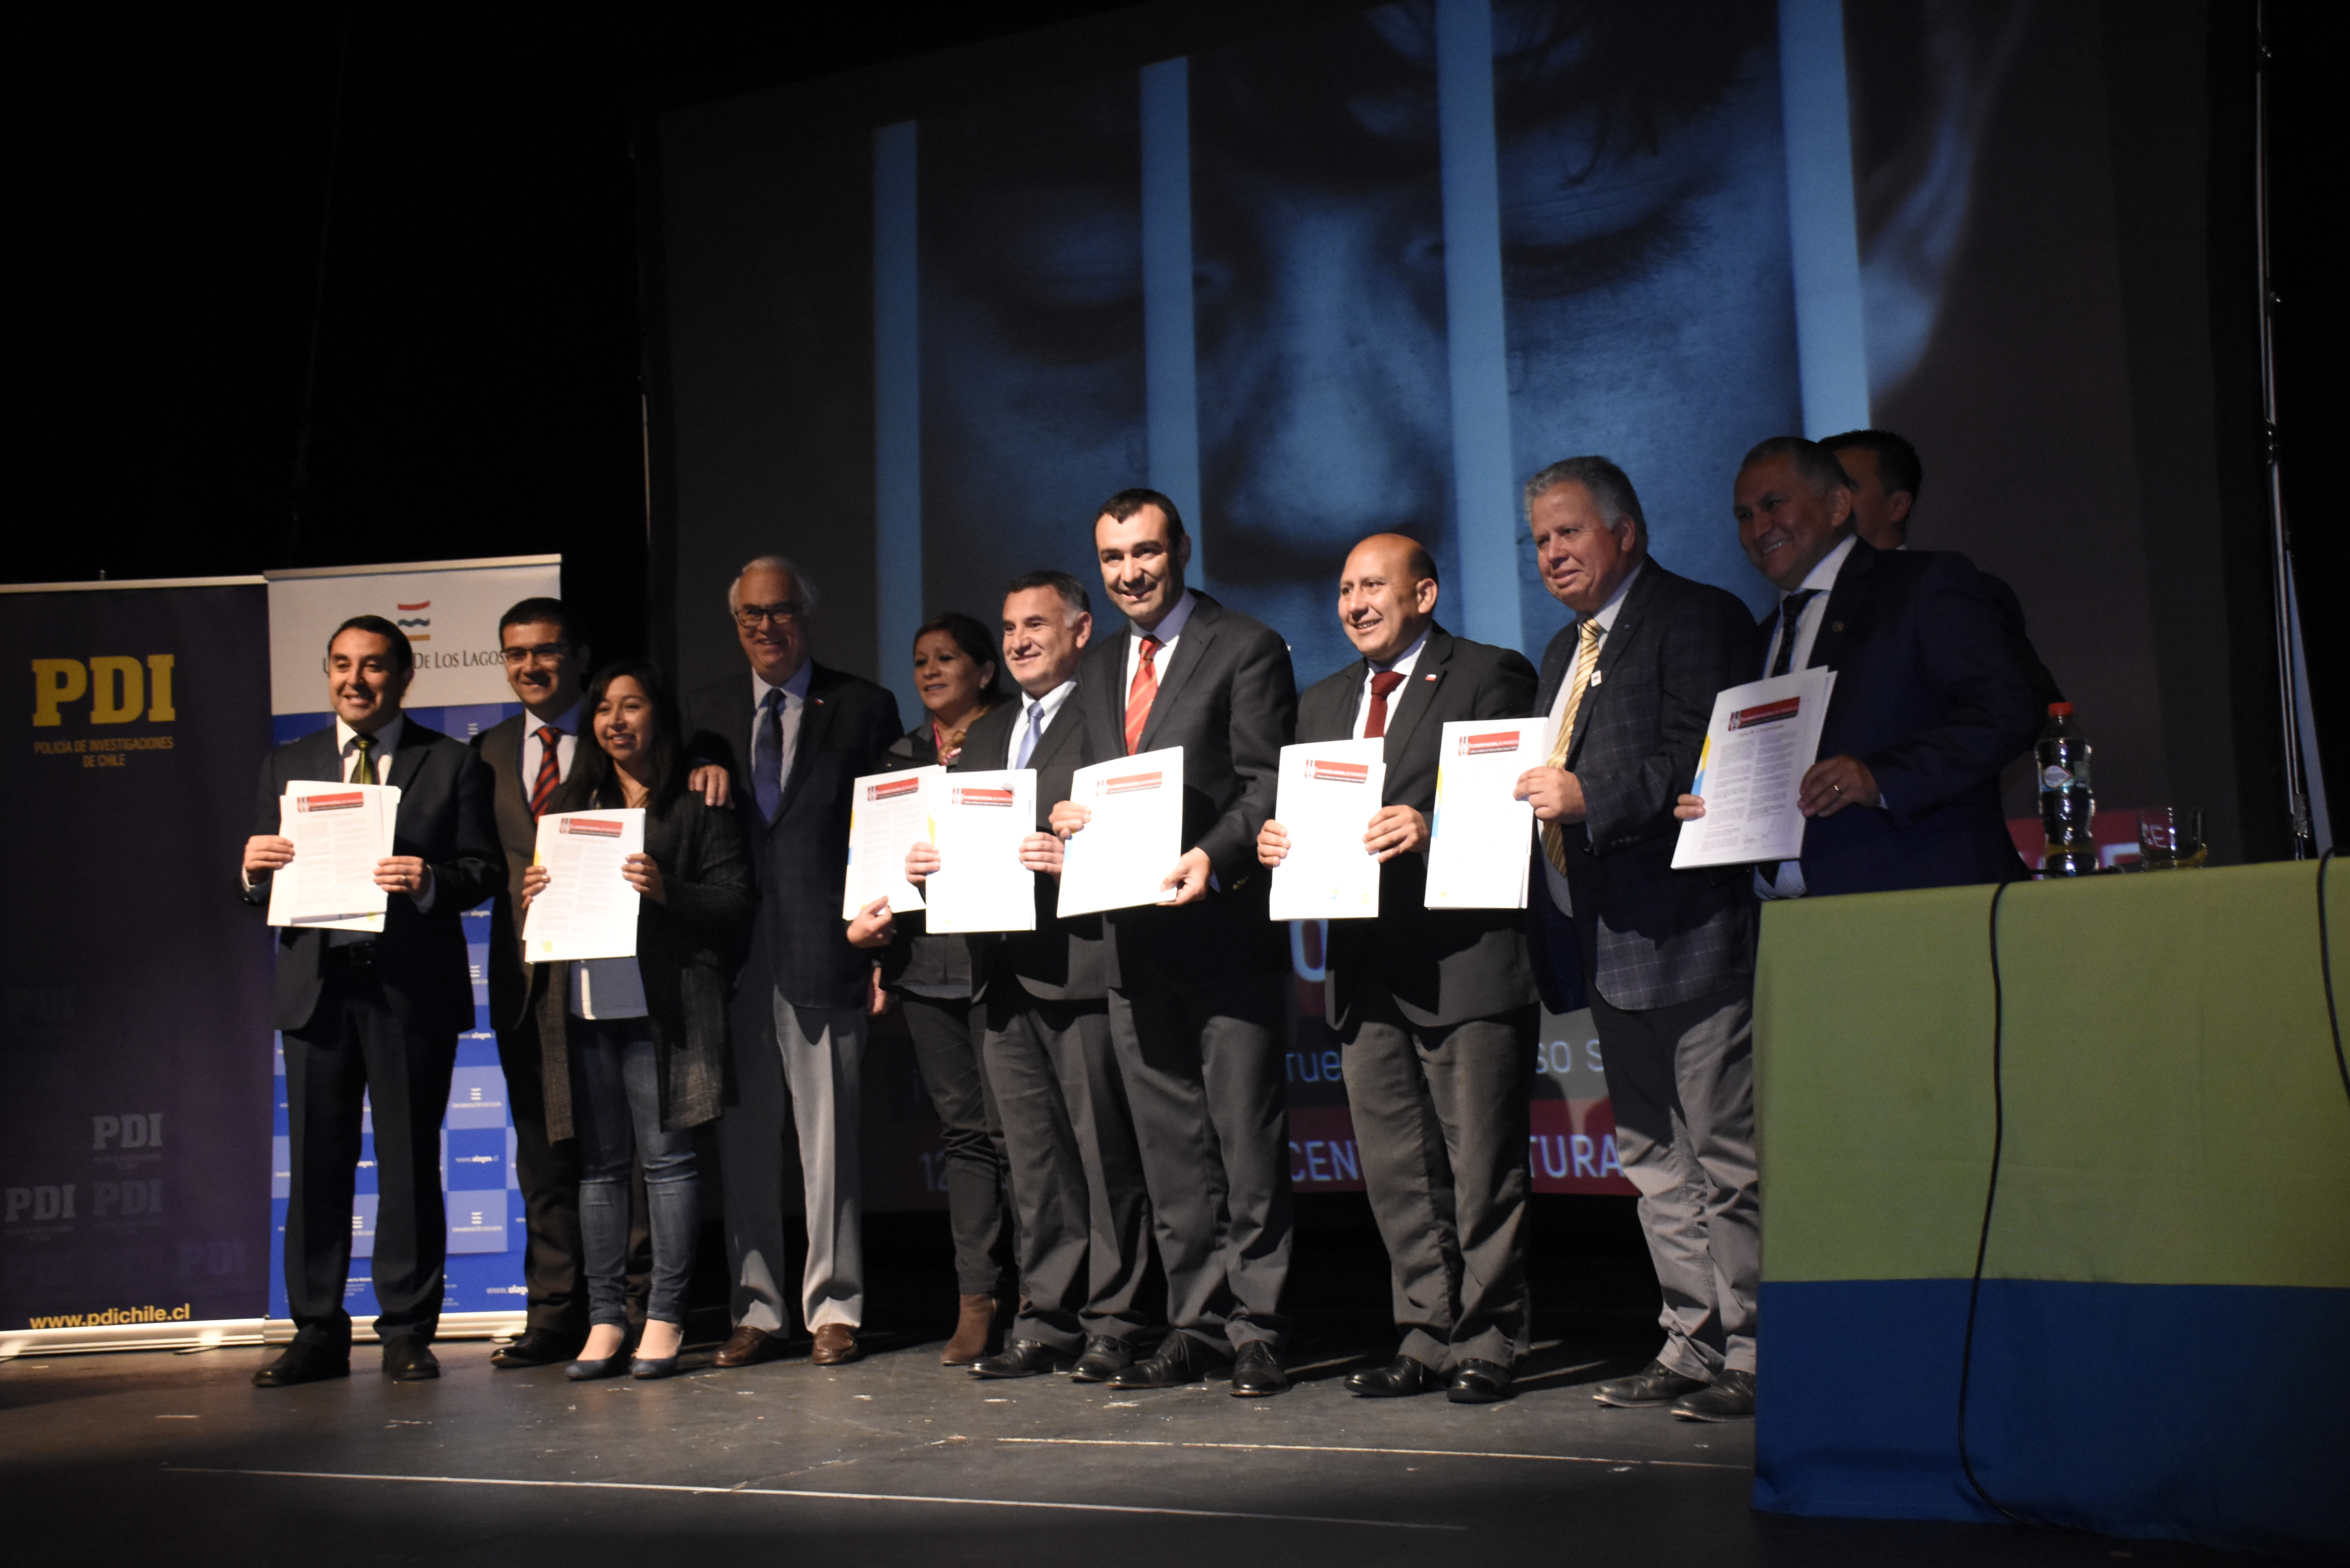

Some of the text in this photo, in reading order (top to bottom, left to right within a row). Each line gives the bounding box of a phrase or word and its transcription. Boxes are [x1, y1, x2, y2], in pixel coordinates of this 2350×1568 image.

[435, 652, 459, 668] LOS
[463, 650, 505, 667] LAGOS
[32, 653, 176, 727] PDI
[74, 740, 87, 753] DE
[88, 736, 174, 751] INVESTIGACIONES
[83, 753, 125, 768] DE CHILE
[92, 1113, 163, 1150] PDI
[1288, 1133, 1625, 1182] CEN TURA
[4, 1183, 77, 1223] PDI
[92, 1178, 163, 1217] PDI
[29, 1302, 190, 1330] www.pdichile.cl
